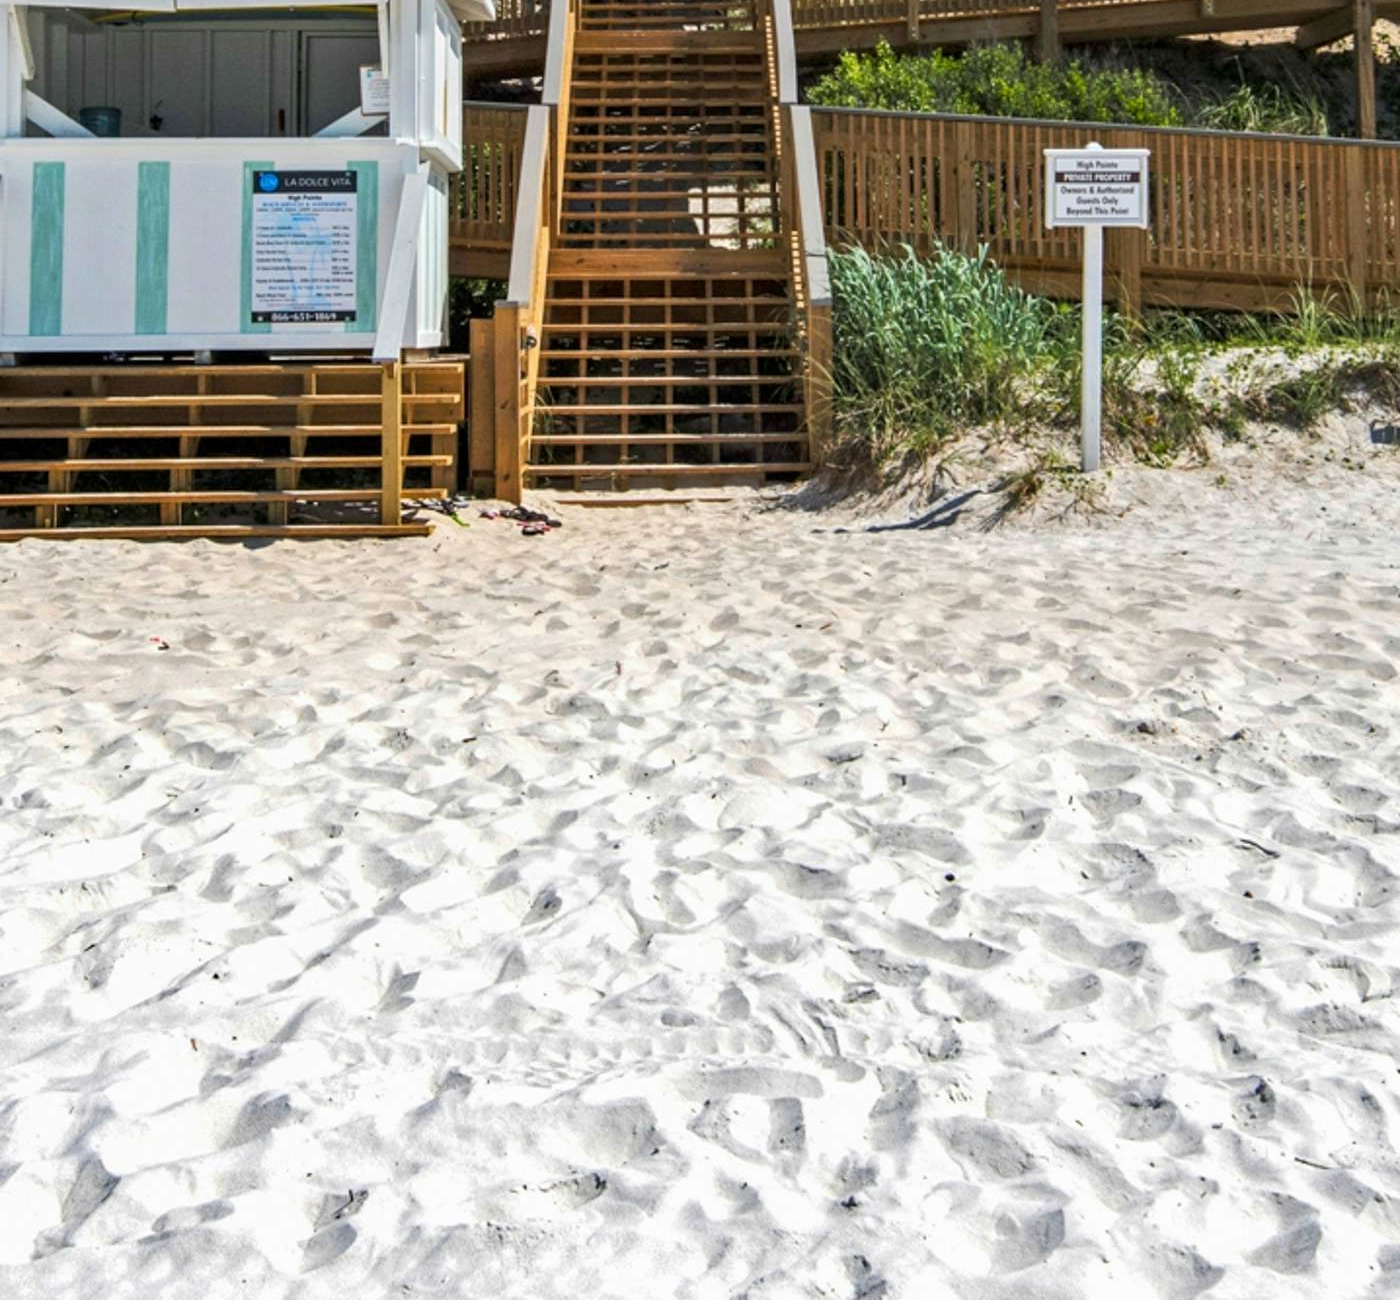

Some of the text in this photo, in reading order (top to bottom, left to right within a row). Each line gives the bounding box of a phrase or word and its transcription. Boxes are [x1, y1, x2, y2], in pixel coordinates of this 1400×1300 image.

[1077, 161, 1094, 170] High
[1064, 173, 1132, 181] PRIVATE PROPERTY
[285, 177, 352, 187] LA DOLCE VITA
[1061, 186, 1087, 194] Owners
[1097, 186, 1134, 194] Authorized
[1102, 197, 1118, 205] Only
[1066, 207, 1129, 216] Beyond This Point
